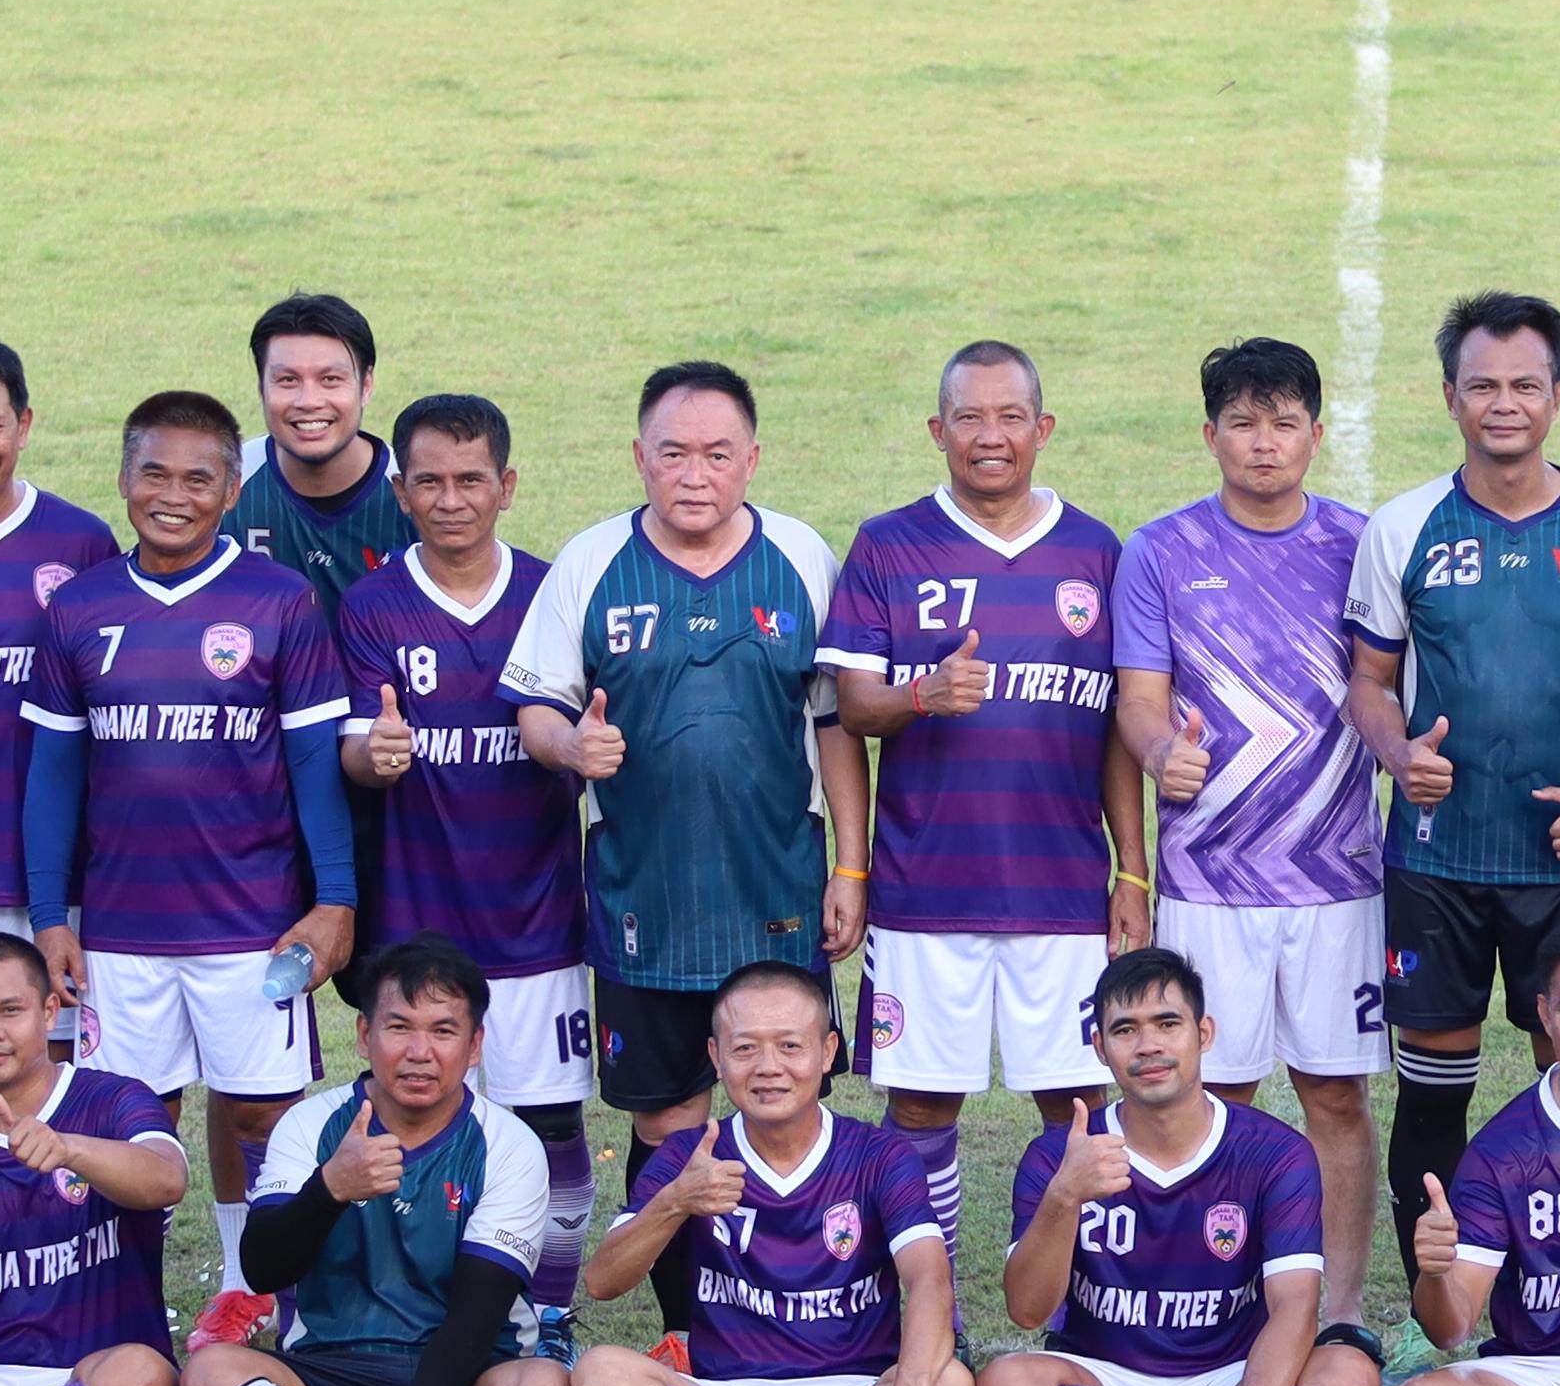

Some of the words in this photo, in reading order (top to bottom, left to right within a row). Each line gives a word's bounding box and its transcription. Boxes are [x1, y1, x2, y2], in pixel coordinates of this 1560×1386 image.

[1424, 539, 1482, 588] 23
[607, 604, 660, 654] 57
[918, 578, 978, 630] 27
[97, 624, 126, 676] 7
[1003, 663, 1069, 703] TREE
[1069, 666, 1114, 713] TAK
[156, 704, 219, 743] TREE
[223, 705, 265, 743] TAK
[555, 1008, 592, 1064] 18
[85, 1215, 122, 1267] TAK
[1079, 1200, 1136, 1256] 20
[697, 1265, 777, 1319] BANANA
[782, 1285, 844, 1323] TREE
[1156, 1288, 1223, 1330] TREE
